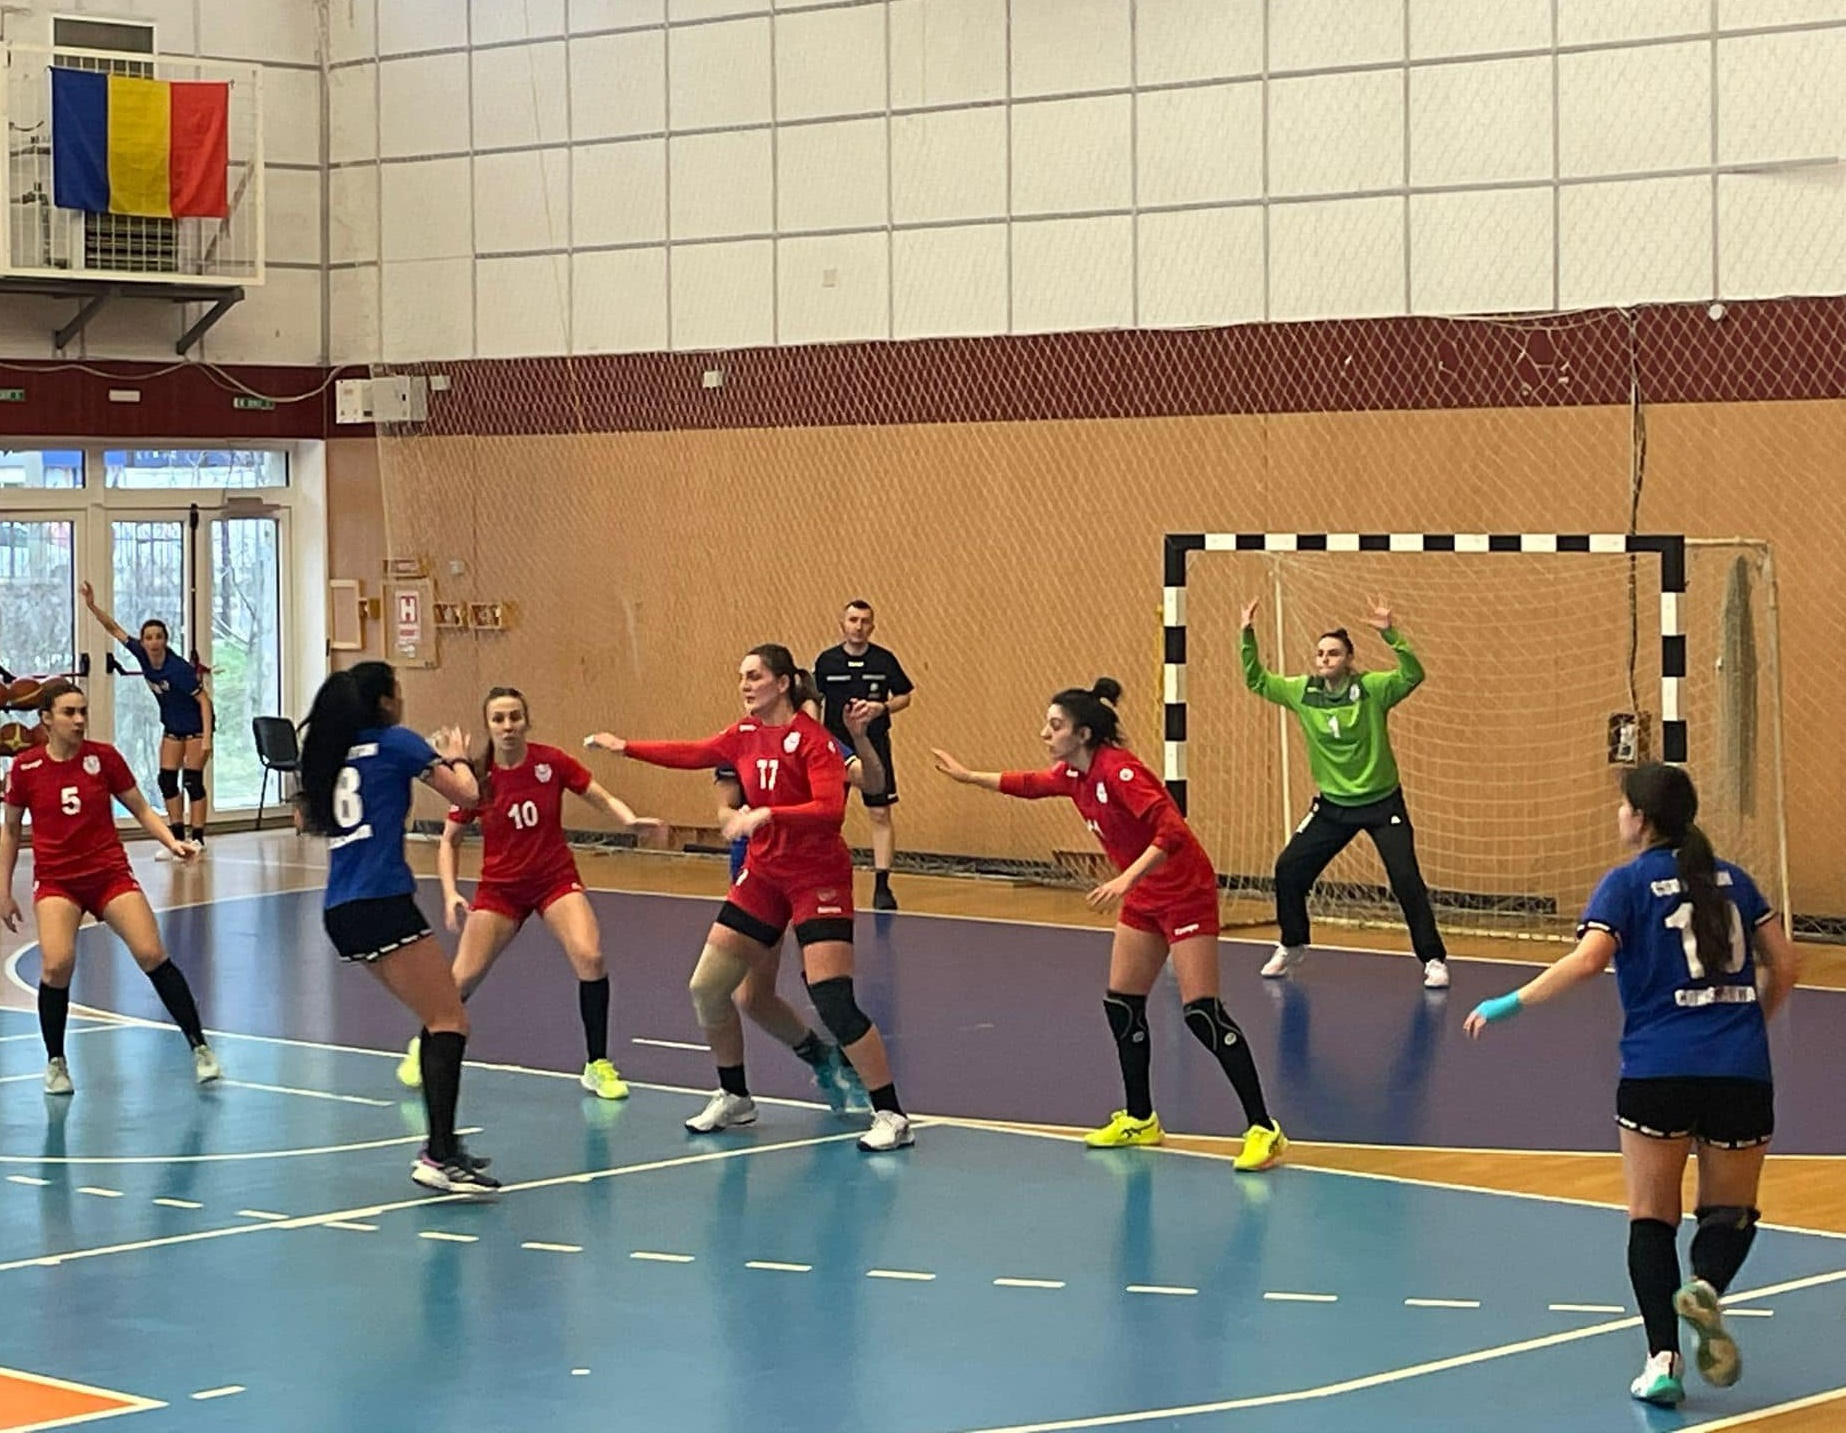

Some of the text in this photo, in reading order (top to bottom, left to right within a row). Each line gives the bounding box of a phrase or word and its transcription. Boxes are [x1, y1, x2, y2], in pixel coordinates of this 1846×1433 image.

[1328, 716, 1341, 738] 1
[756, 759, 779, 791] 17
[61, 786, 81, 815] 5
[333, 766, 363, 828] 8
[507, 800, 538, 830] 10
